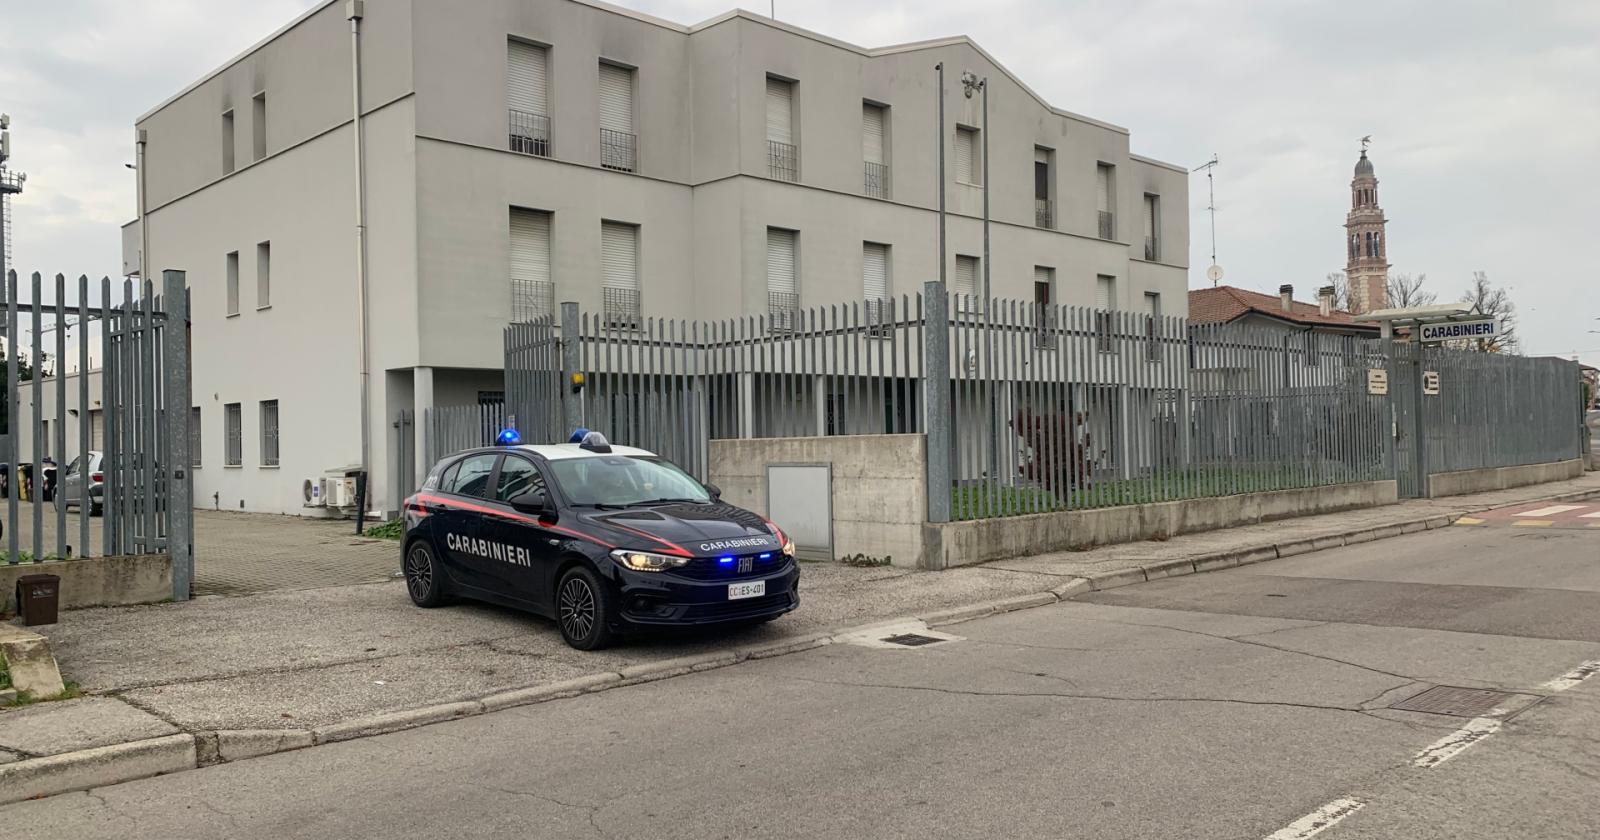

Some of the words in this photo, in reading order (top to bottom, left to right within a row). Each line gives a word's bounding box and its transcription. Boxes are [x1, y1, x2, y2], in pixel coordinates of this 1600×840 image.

[1423, 322, 1494, 339] CARABINIERI
[446, 532, 531, 568] CARABINIERI
[700, 538, 769, 551] CARABINIERI
[737, 557, 754, 573] FIAT
